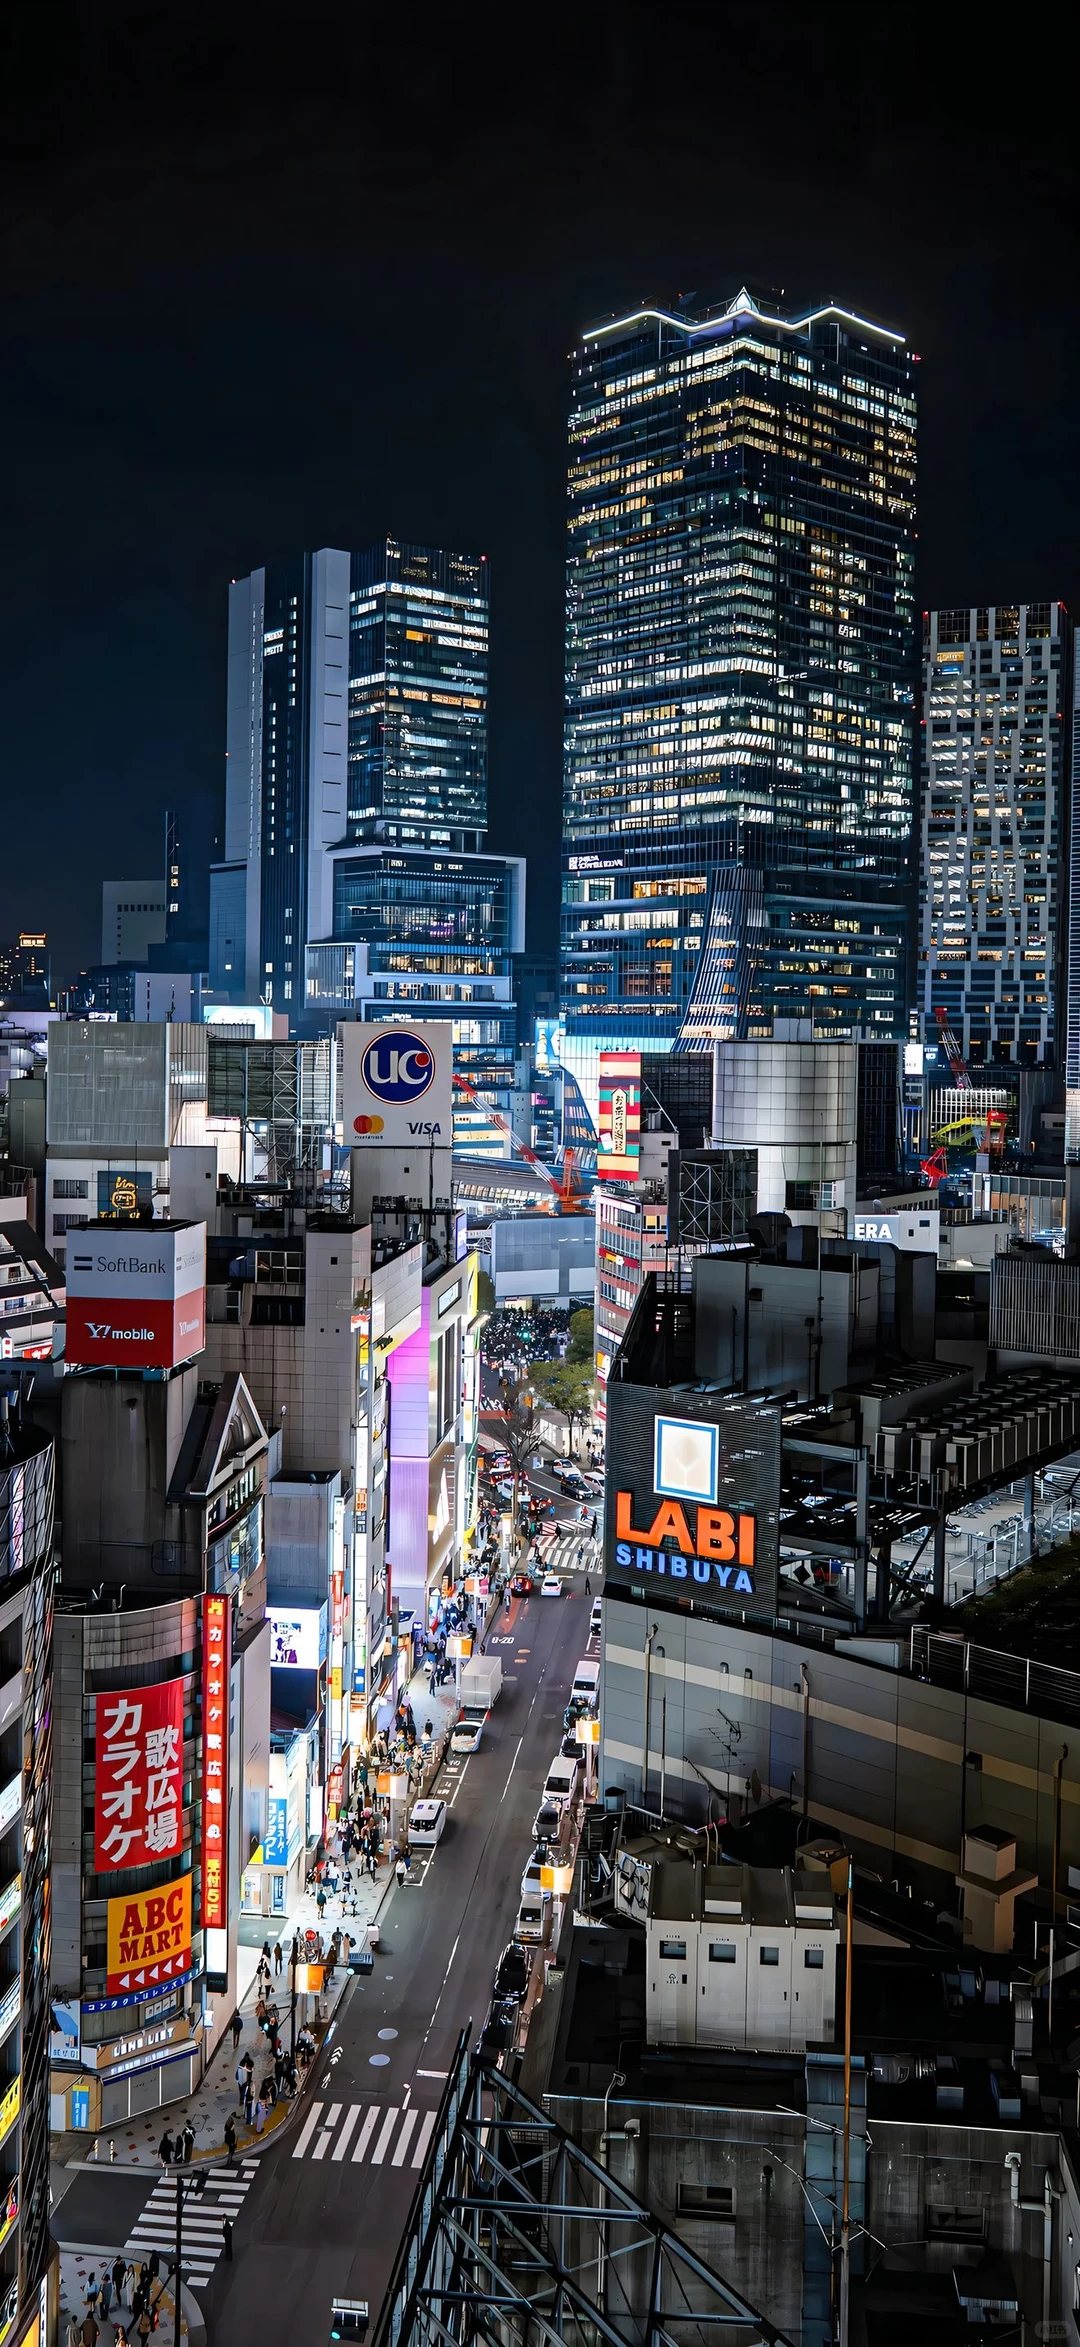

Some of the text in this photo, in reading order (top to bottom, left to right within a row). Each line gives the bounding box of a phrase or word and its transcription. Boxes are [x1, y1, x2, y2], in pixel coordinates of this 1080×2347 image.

[406, 1122, 441, 1134] VISA
[97, 1256, 166, 1273] SoftBank
[616, 1491, 755, 1567] LABI
[616, 1543, 754, 1593] SHIBUYA
[101, 1699, 143, 1863] カラオケ
[144, 1725, 179, 1853] 歌広場
[120, 1887, 184, 1939] ABC
[119, 1922, 184, 1964] MART
